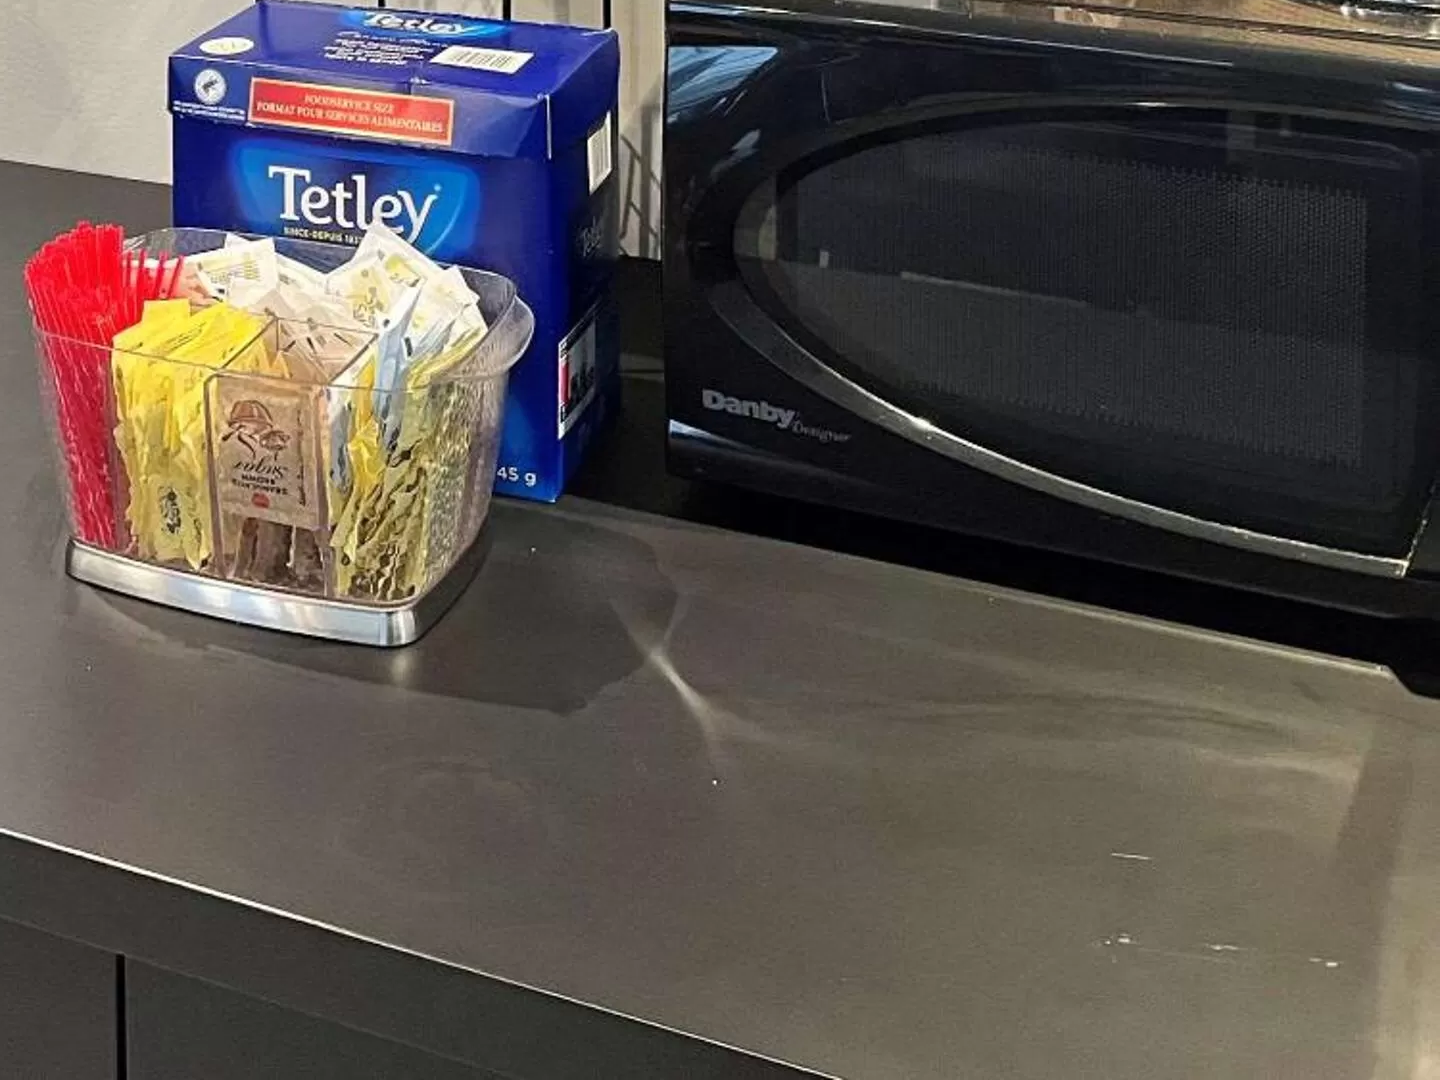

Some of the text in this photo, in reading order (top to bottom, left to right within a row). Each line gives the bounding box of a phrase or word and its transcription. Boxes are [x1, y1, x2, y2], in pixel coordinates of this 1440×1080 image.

[362, 11, 471, 36] Tetley
[256, 101, 295, 117] FORMAT
[296, 106, 323, 120] POUR
[371, 115, 444, 133] ALIMENTAIRES
[373, 101, 396, 114] SIZE
[268, 165, 442, 245] Tetley
[702, 388, 796, 429] Danby
[523, 472, 537, 488] g
